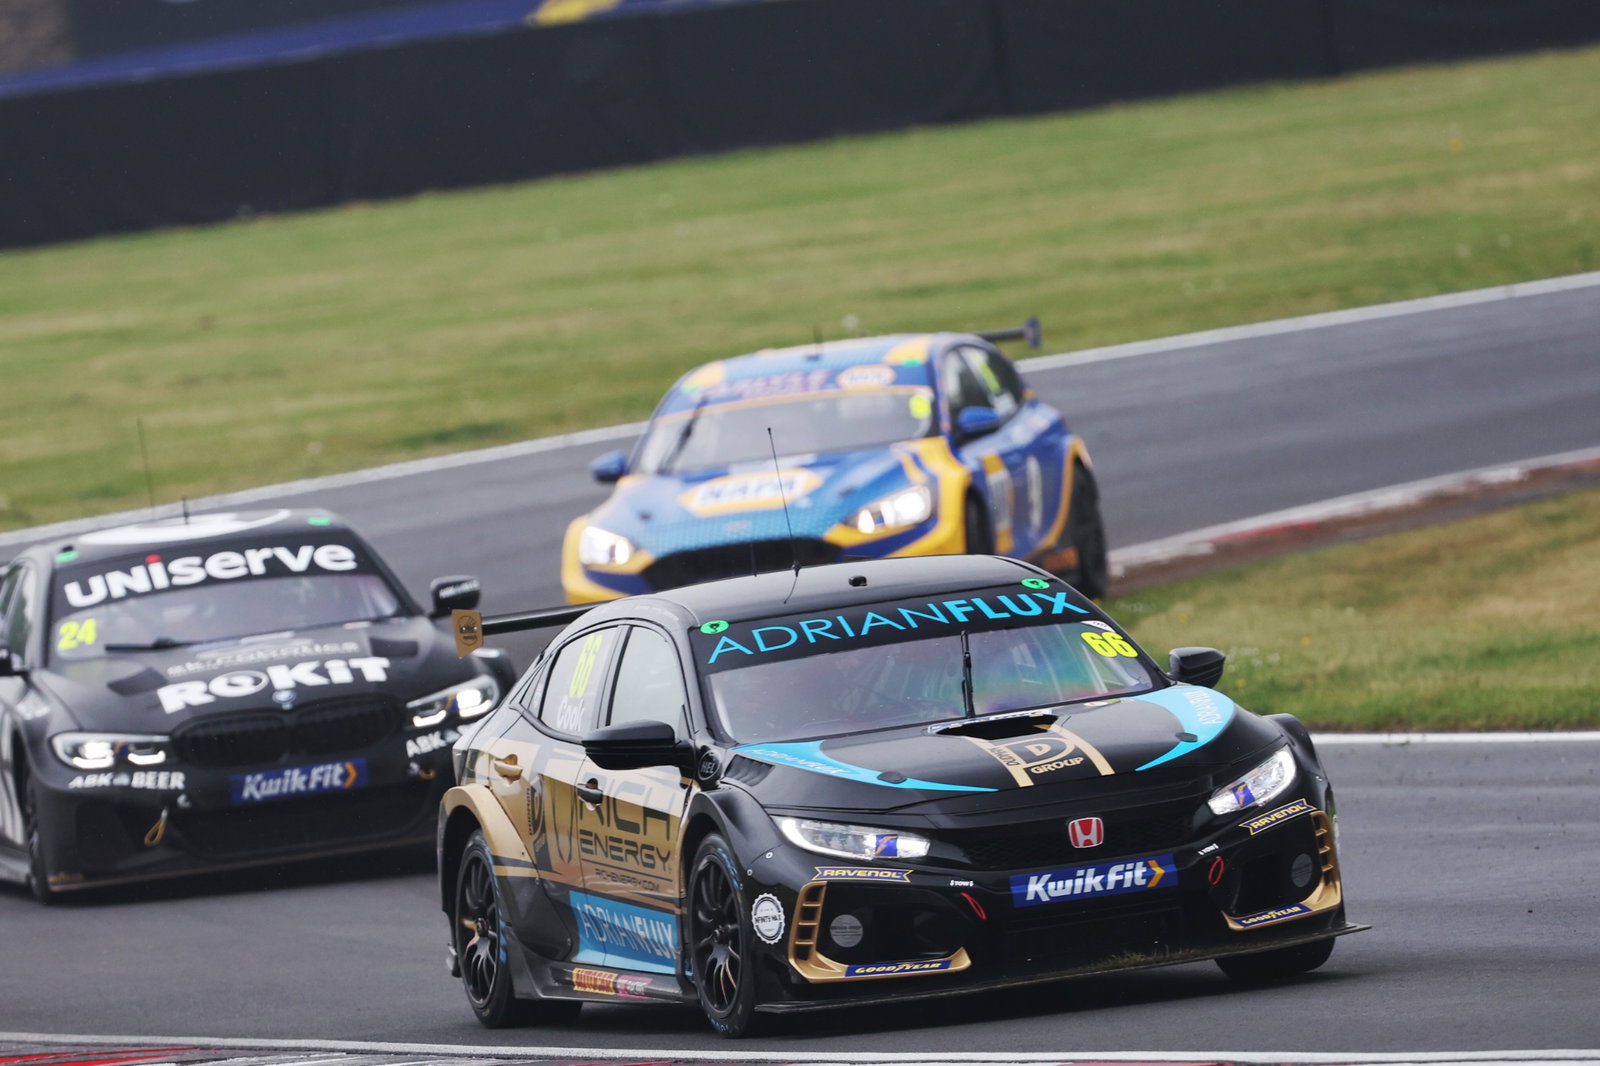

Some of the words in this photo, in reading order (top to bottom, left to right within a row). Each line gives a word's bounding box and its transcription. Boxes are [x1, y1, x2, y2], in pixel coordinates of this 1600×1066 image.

[58, 618, 97, 651] 24
[1080, 632, 1139, 658] 66
[568, 632, 604, 698] 66
[556, 696, 585, 732] Cook
[701, 761, 716, 774] HEL
[1030, 757, 1085, 774] GROUP
[68, 773, 114, 789] ABK
[131, 772, 185, 790] BEER
[1250, 804, 1307, 829] RAVENOL
[579, 829, 672, 872] ENERGY
[822, 869, 901, 879] RAVENOL
[855, 962, 942, 974] GOODYEAR
